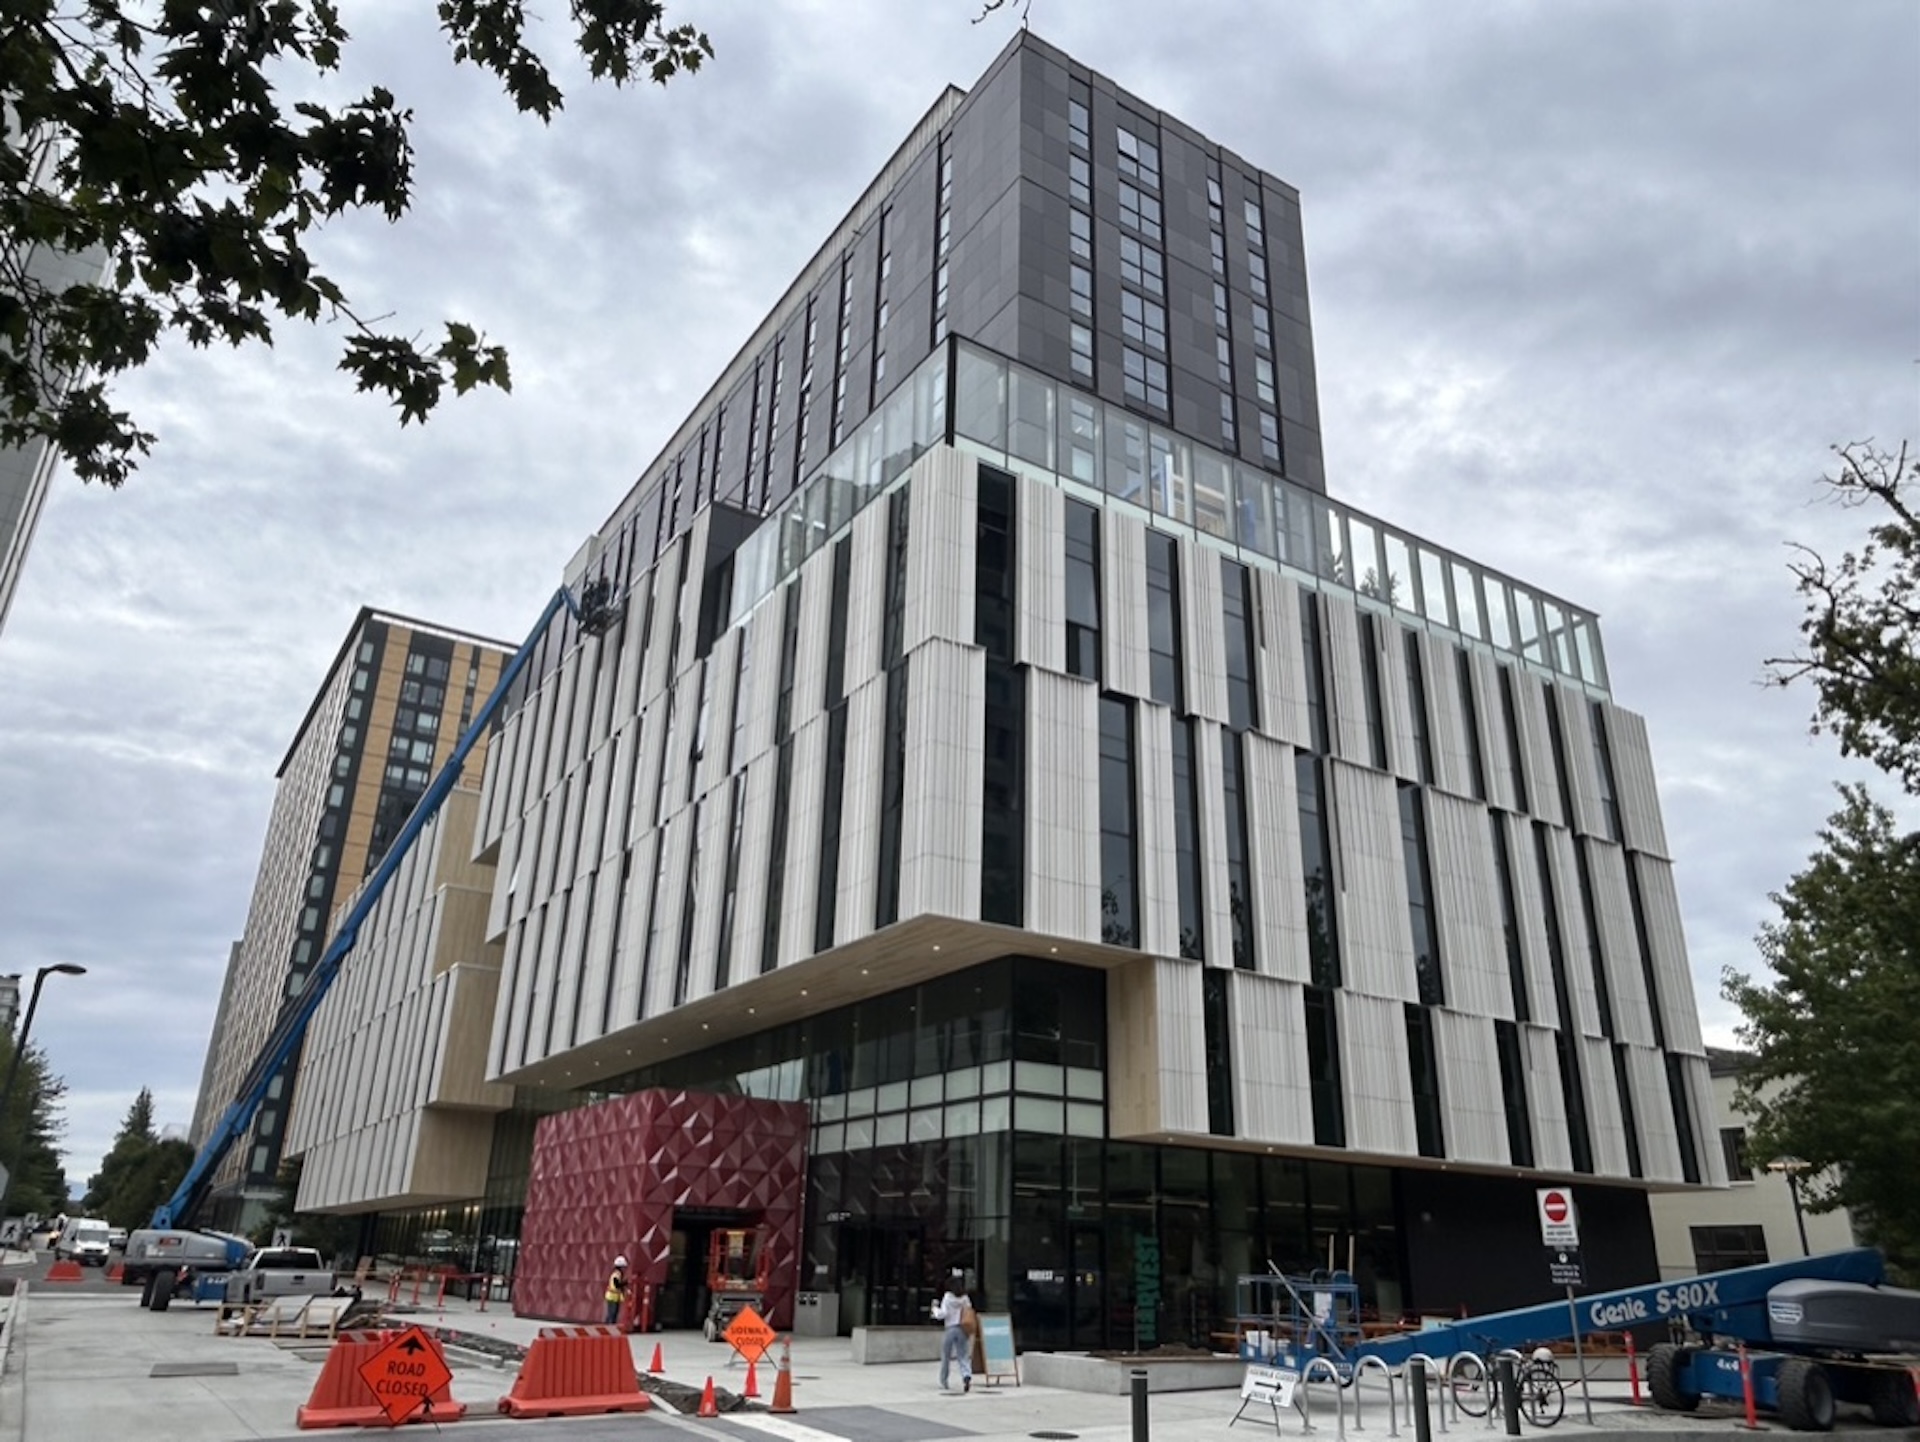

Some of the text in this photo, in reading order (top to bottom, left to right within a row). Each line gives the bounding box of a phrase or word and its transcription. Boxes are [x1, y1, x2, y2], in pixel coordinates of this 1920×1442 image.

[1134, 1232, 1160, 1341] HARVEST
[1590, 1281, 1720, 1327] Genie S-80X
[387, 1360, 426, 1377] ROAD
[1716, 1358, 1739, 1371] 4x4
[376, 1378, 429, 1398] CLOSED
